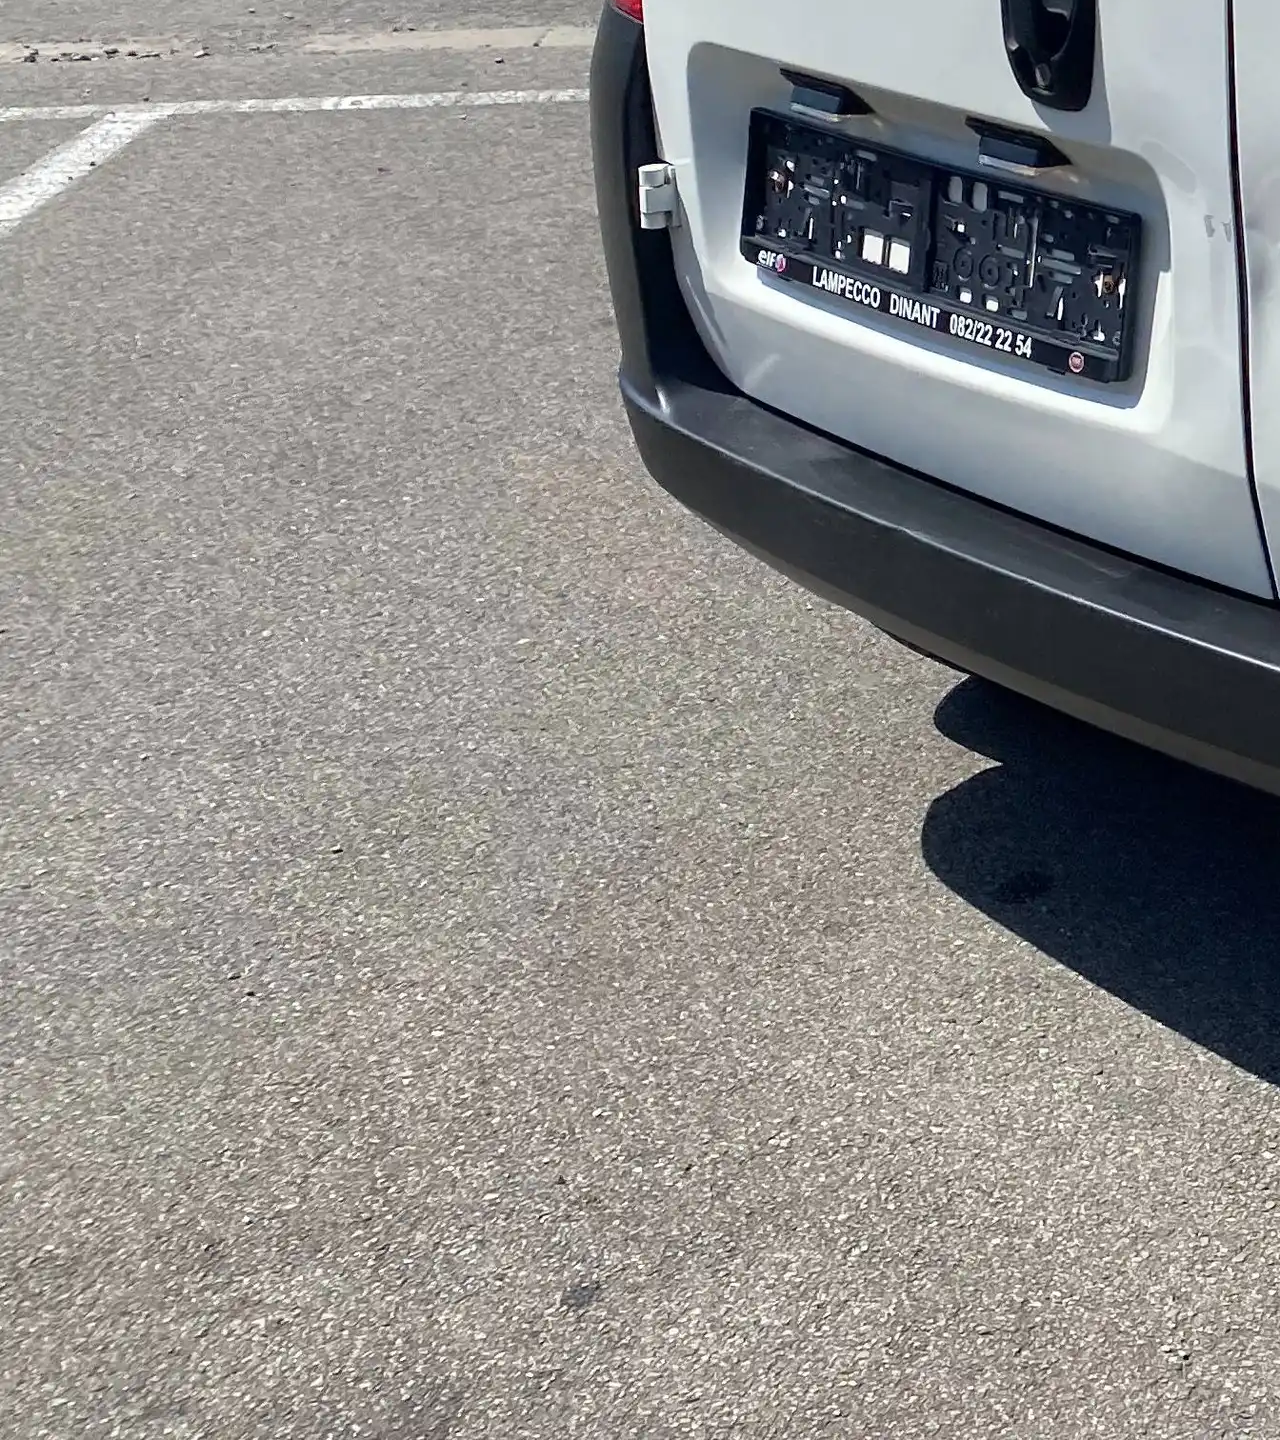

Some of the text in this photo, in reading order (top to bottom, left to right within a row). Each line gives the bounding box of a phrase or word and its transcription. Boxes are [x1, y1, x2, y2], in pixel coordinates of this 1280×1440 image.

[812, 266, 1032, 359] LAMPECCO DINANT 082/22 22 54
